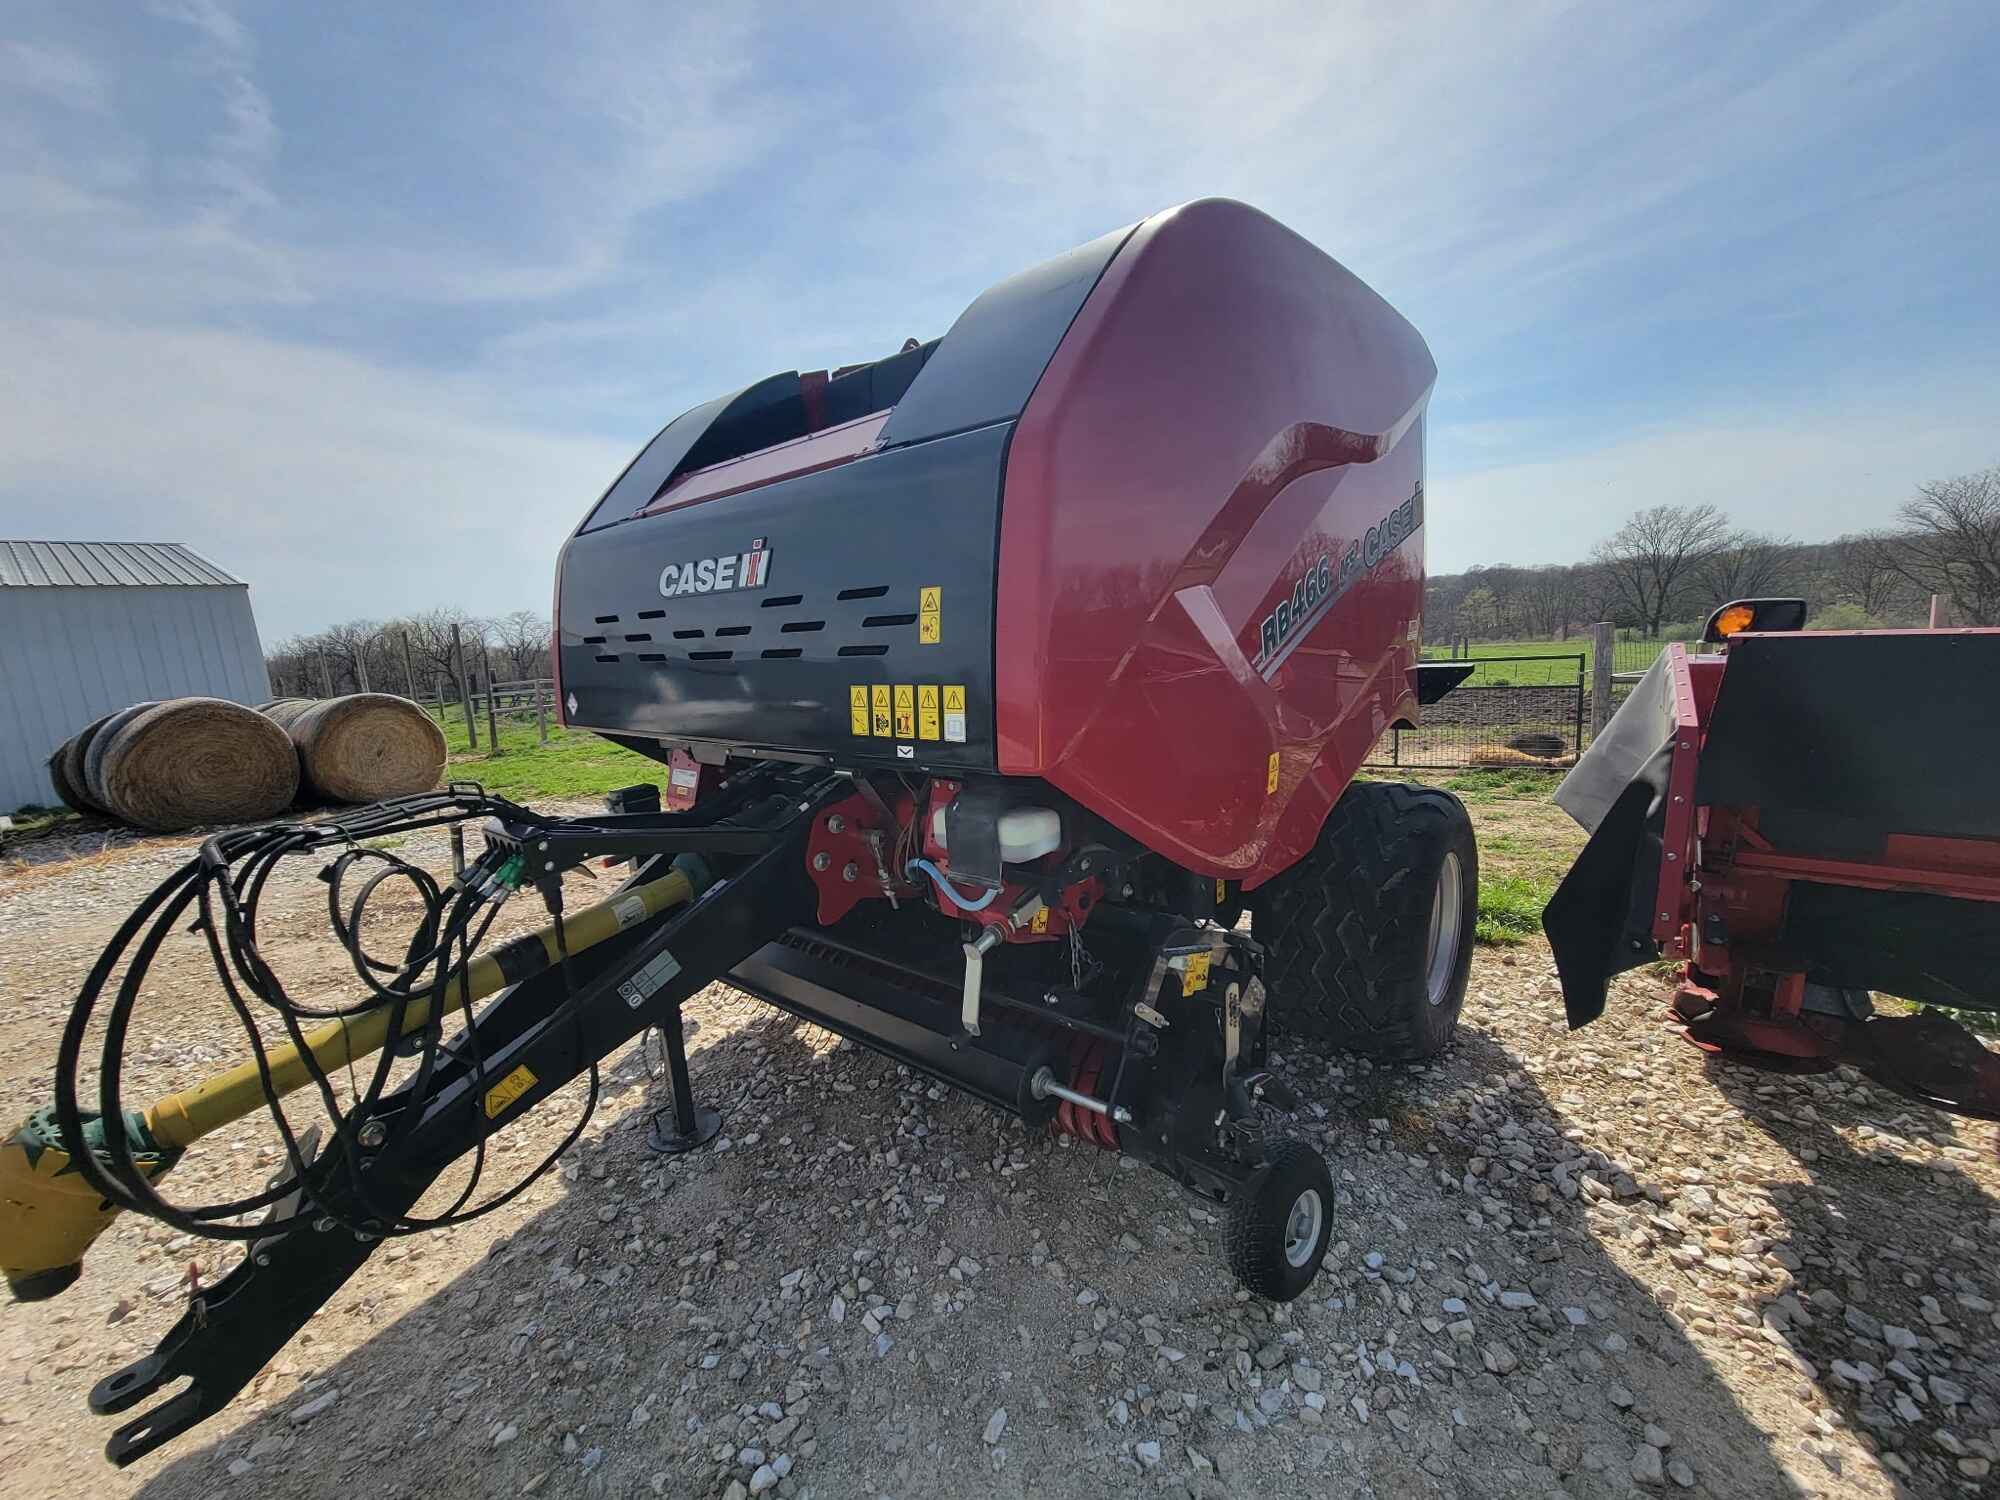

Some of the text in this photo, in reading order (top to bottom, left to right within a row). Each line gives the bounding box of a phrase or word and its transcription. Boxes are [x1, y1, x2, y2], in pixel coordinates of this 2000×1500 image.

[659, 555, 738, 598] CASE
[1260, 554, 1329, 661] RB466
[1363, 498, 1411, 568] CASE
